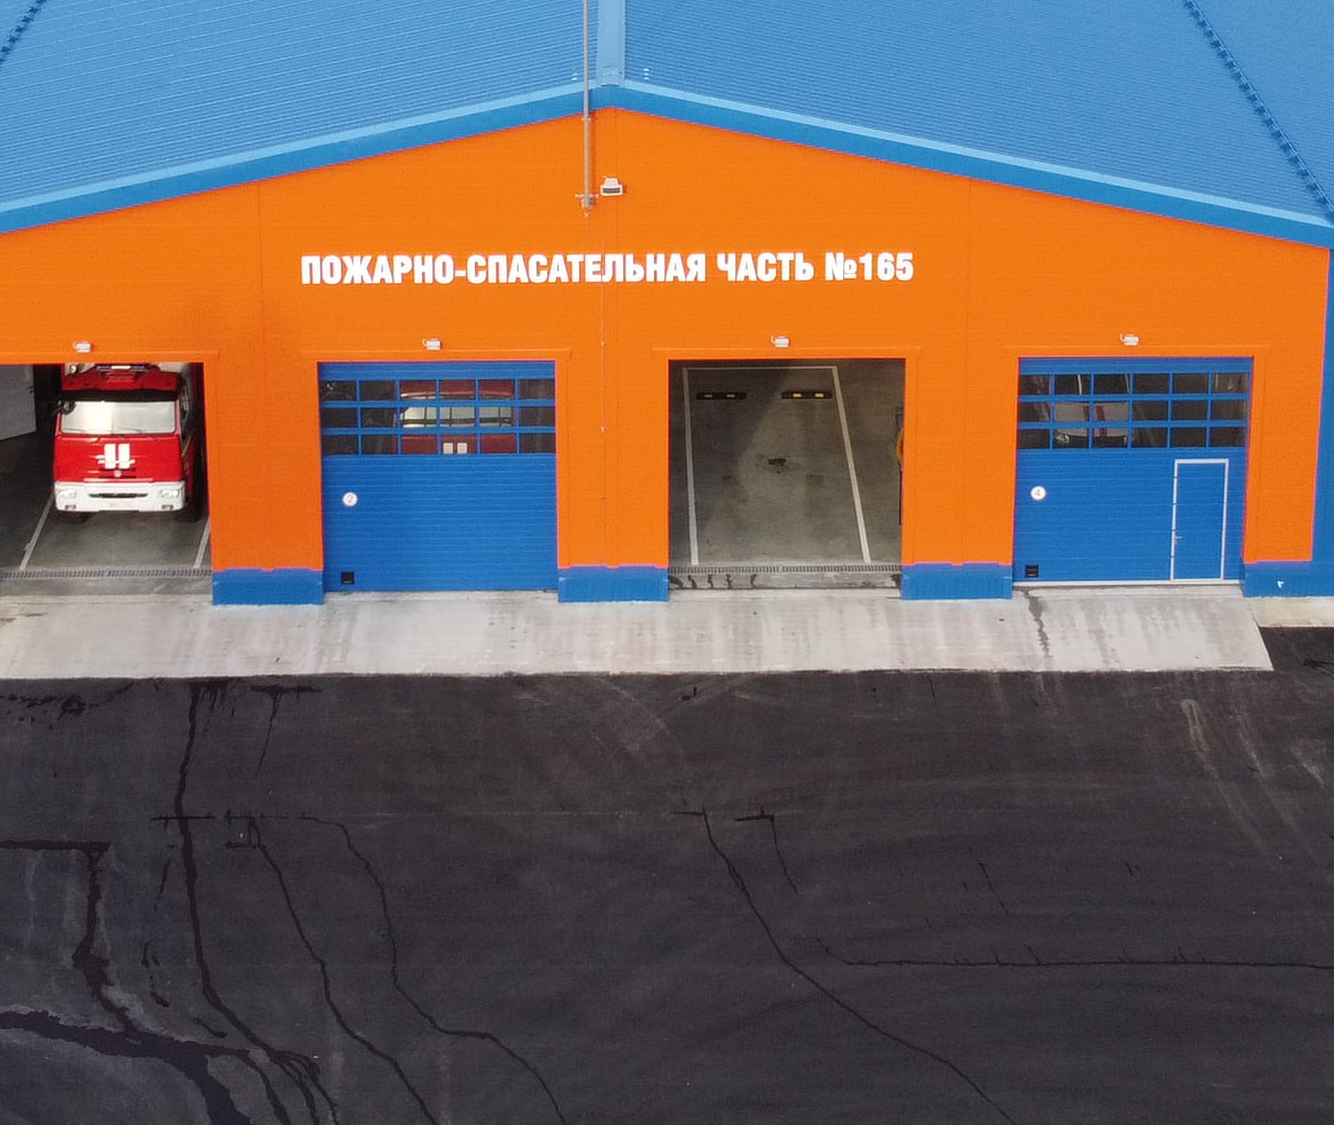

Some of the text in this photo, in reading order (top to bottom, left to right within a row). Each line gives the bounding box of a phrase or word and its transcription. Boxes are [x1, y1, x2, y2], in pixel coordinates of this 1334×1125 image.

[300, 251, 914, 284] ПОЖАРНО-СПАСАТЕЛЬНАЯ ЧАСТЬ №165
